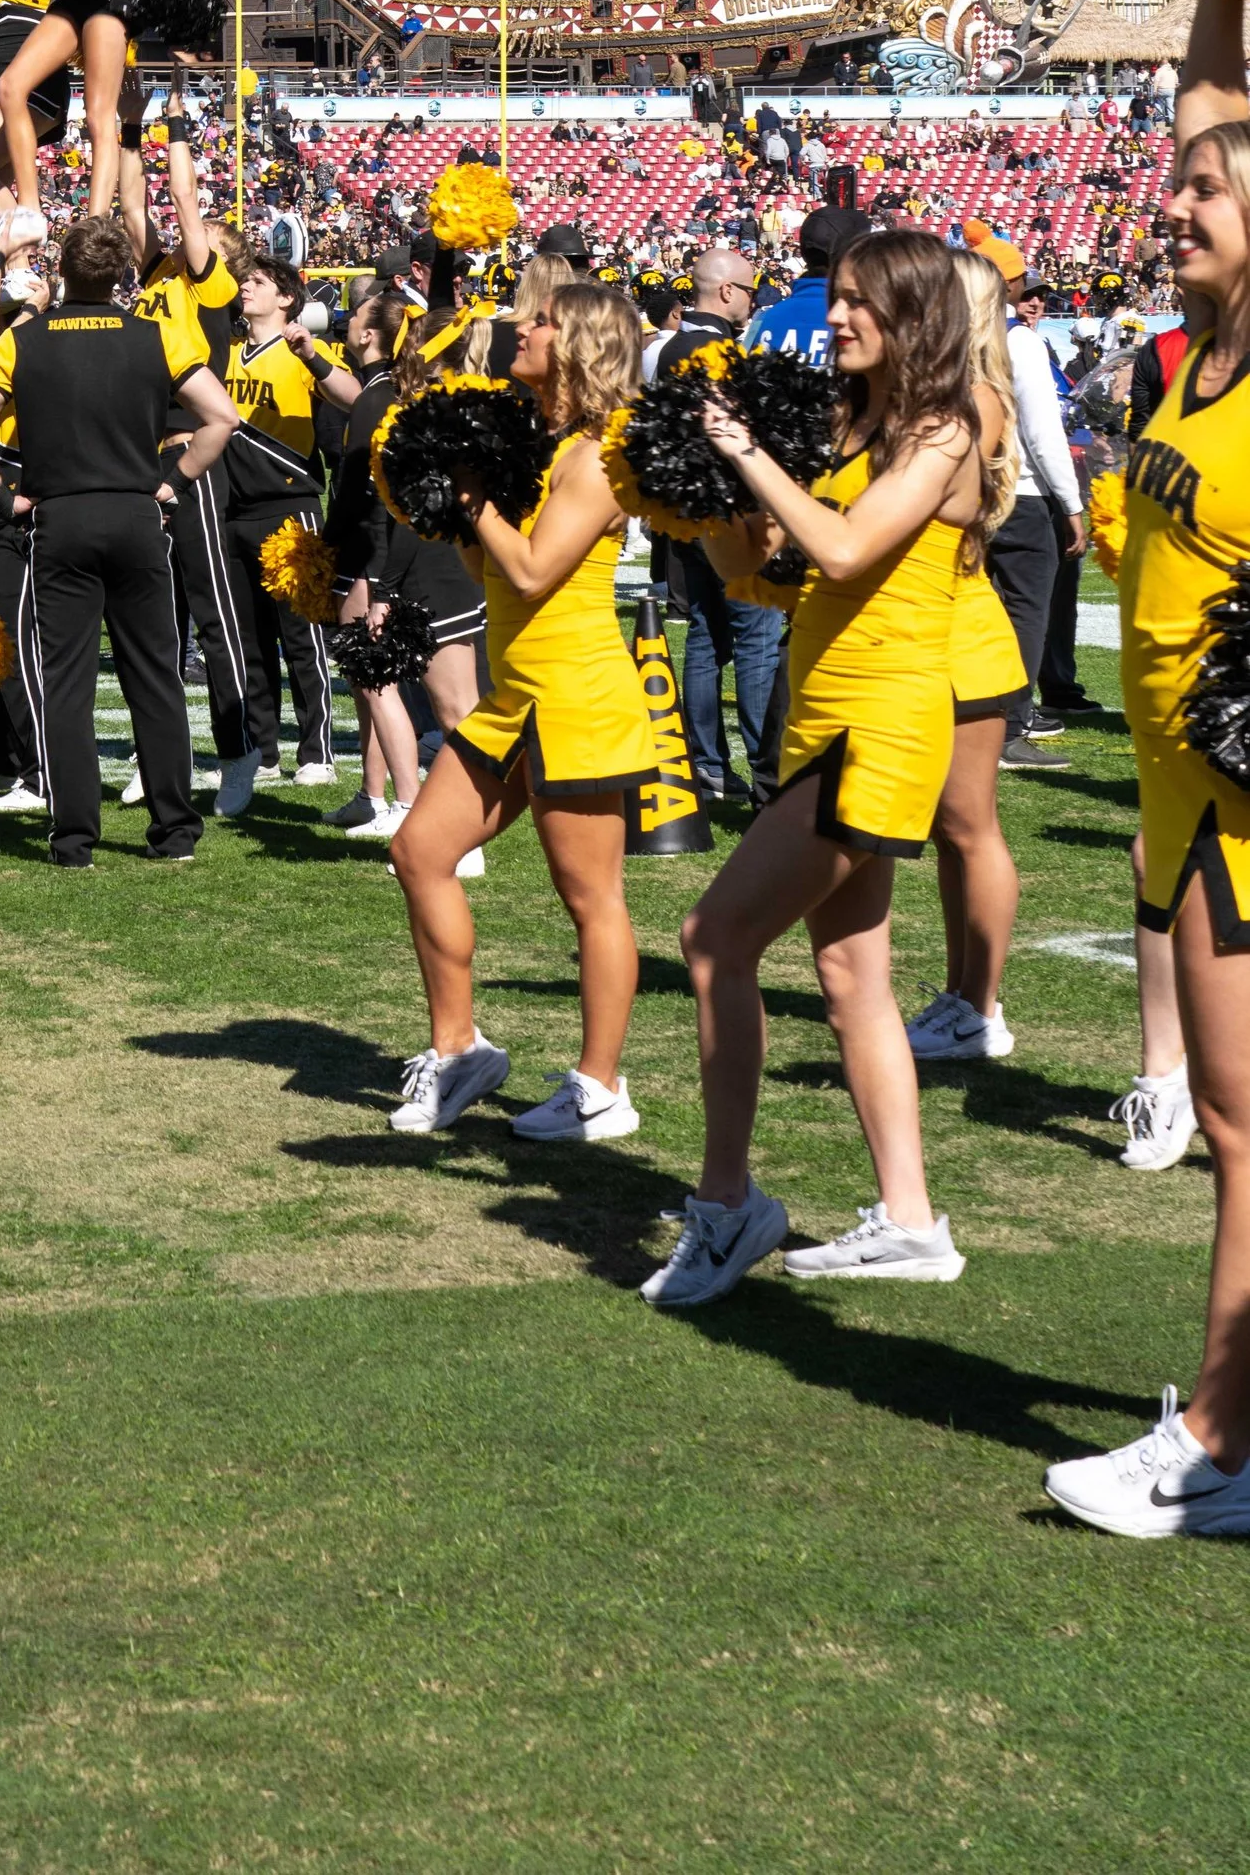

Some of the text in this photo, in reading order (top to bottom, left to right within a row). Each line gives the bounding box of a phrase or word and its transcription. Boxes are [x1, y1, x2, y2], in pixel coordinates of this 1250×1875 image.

[47, 316, 124, 331] HAWKEYES
[225, 377, 275, 407] OWA
[636, 634, 699, 832] IOWA
